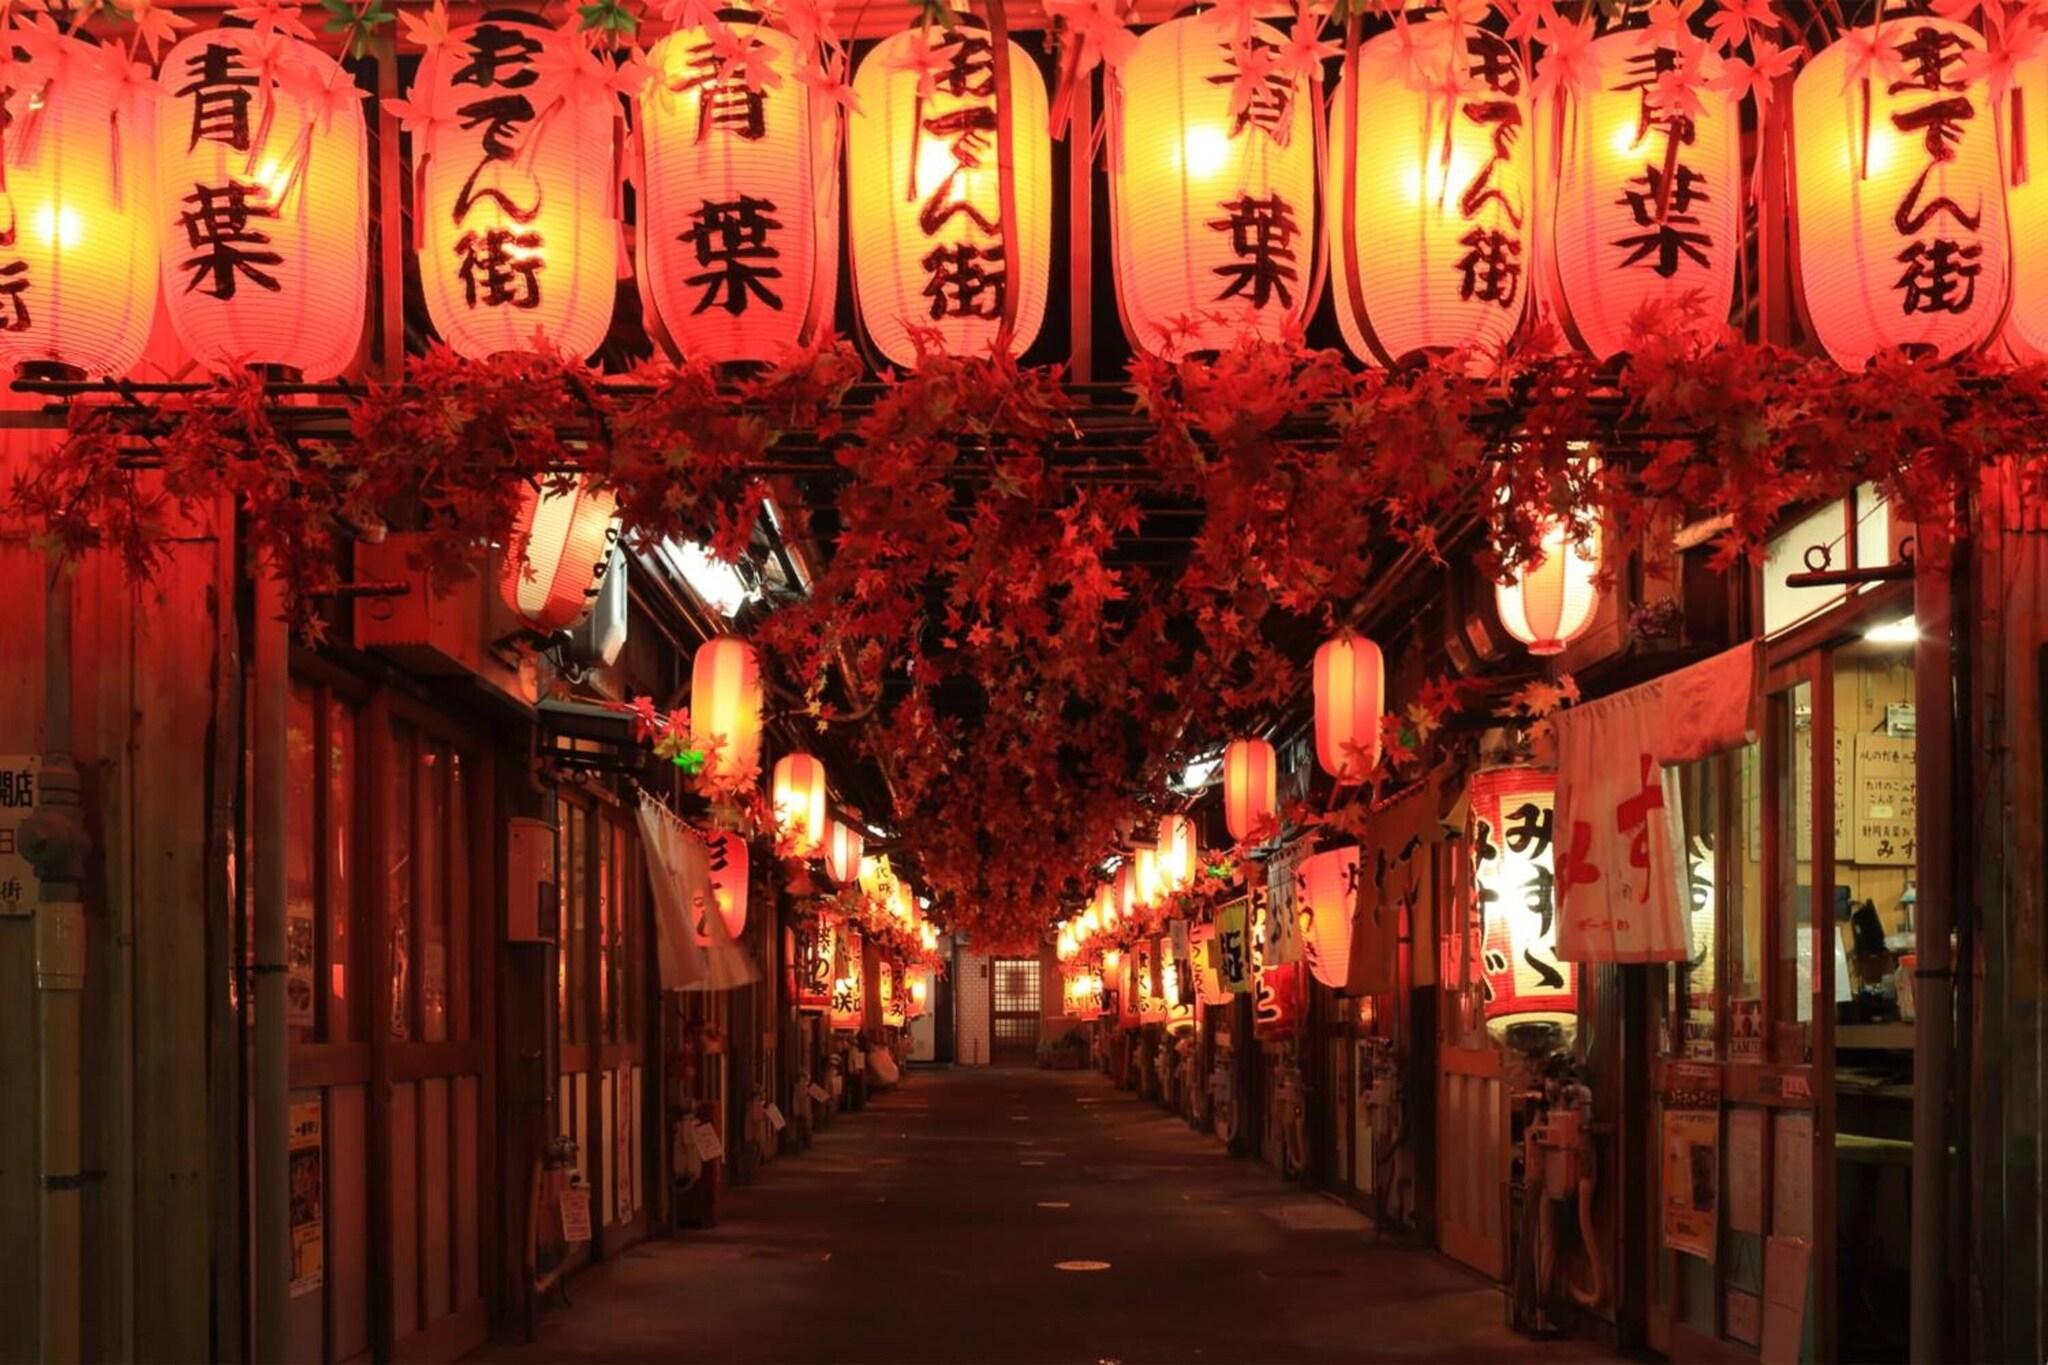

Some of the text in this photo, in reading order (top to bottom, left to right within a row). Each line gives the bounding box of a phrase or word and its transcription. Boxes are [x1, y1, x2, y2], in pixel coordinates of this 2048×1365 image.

[175, 43, 283, 300] 青葉
[452, 24, 547, 309] おでん街
[669, 40, 784, 317] 青葉
[919, 32, 1003, 321] おでん街
[1204, 36, 1301, 310] 青葉
[1457, 31, 1525, 309] おでん街
[1608, 46, 1712, 279] 青葉
[1887, 26, 1984, 316] おでん街
